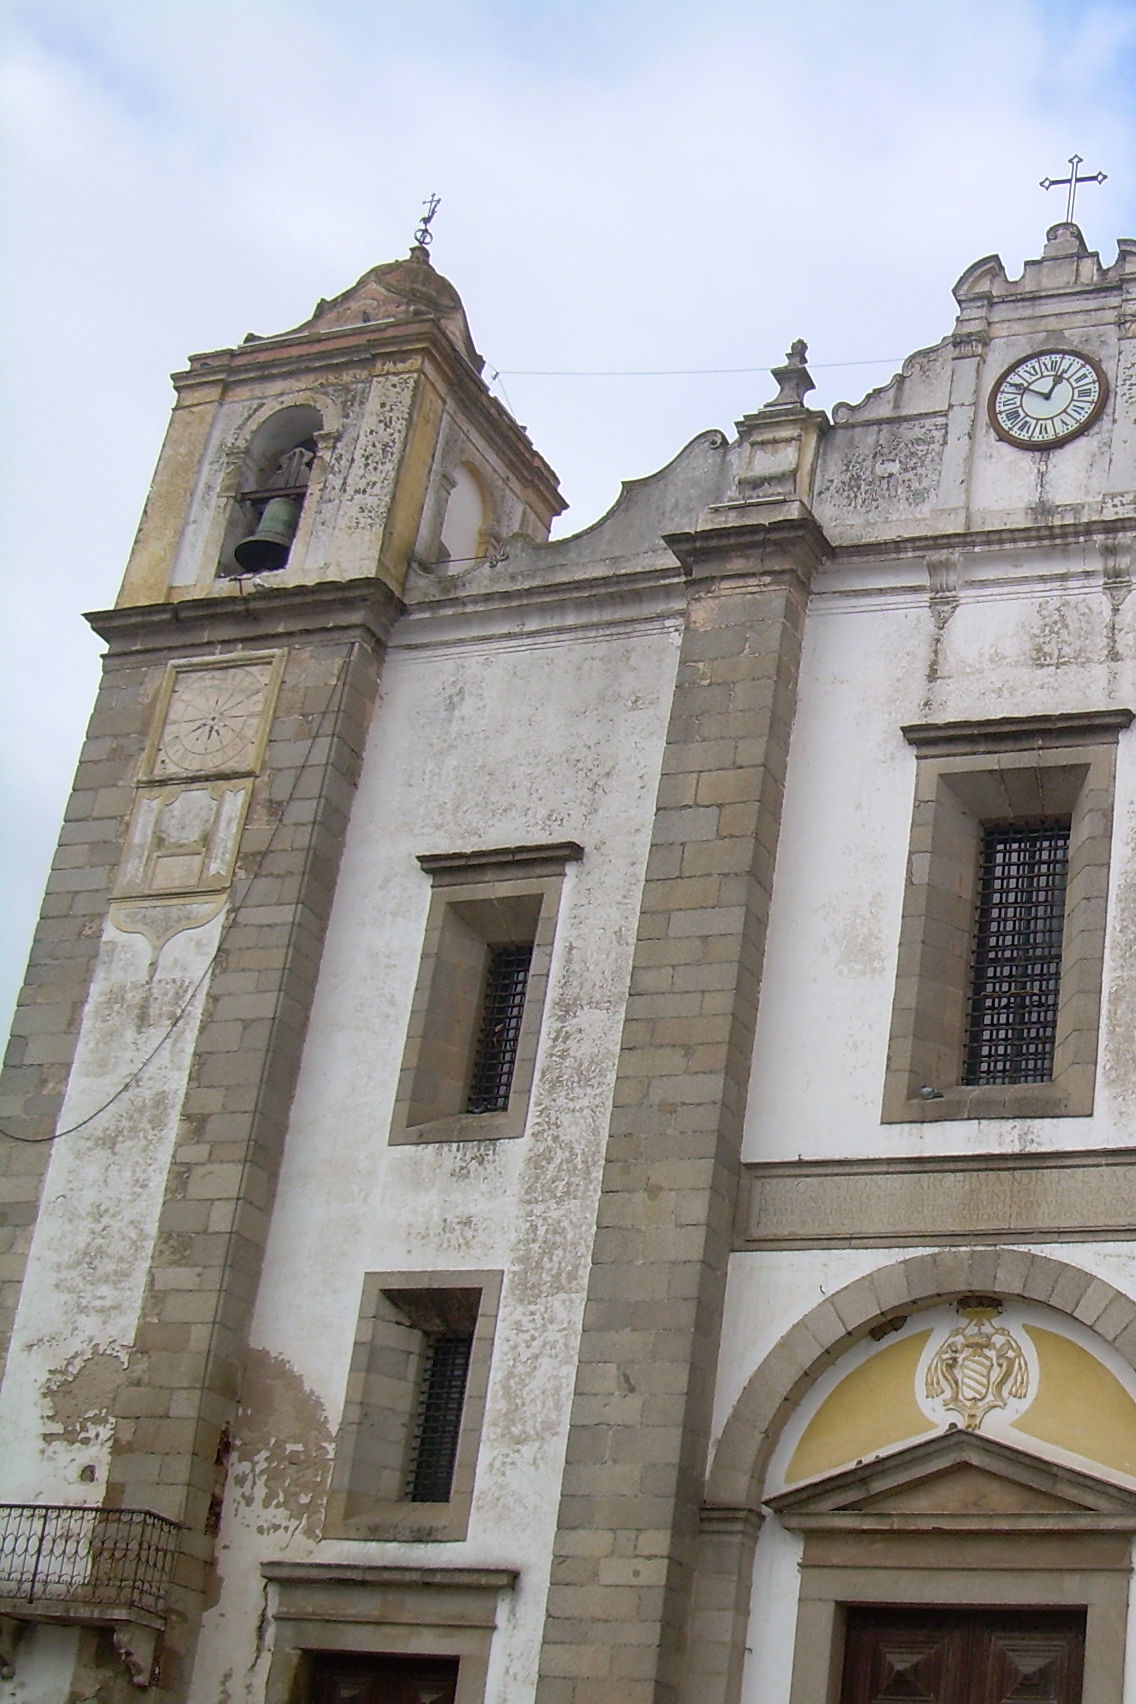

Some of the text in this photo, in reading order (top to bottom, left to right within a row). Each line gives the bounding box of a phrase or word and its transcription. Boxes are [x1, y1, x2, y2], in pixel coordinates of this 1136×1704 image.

[1043, 360, 1058, 372] XII
[1023, 366, 1039, 379] XI
[1075, 373, 1089, 384] II
[1078, 388, 1092, 398] III
[1003, 396, 1018, 407] IX
[1005, 409, 1021, 425] VIII
[1017, 420, 1031, 434] VII
[1038, 423, 1049, 435] VI
[1060, 418, 1070, 429] V
